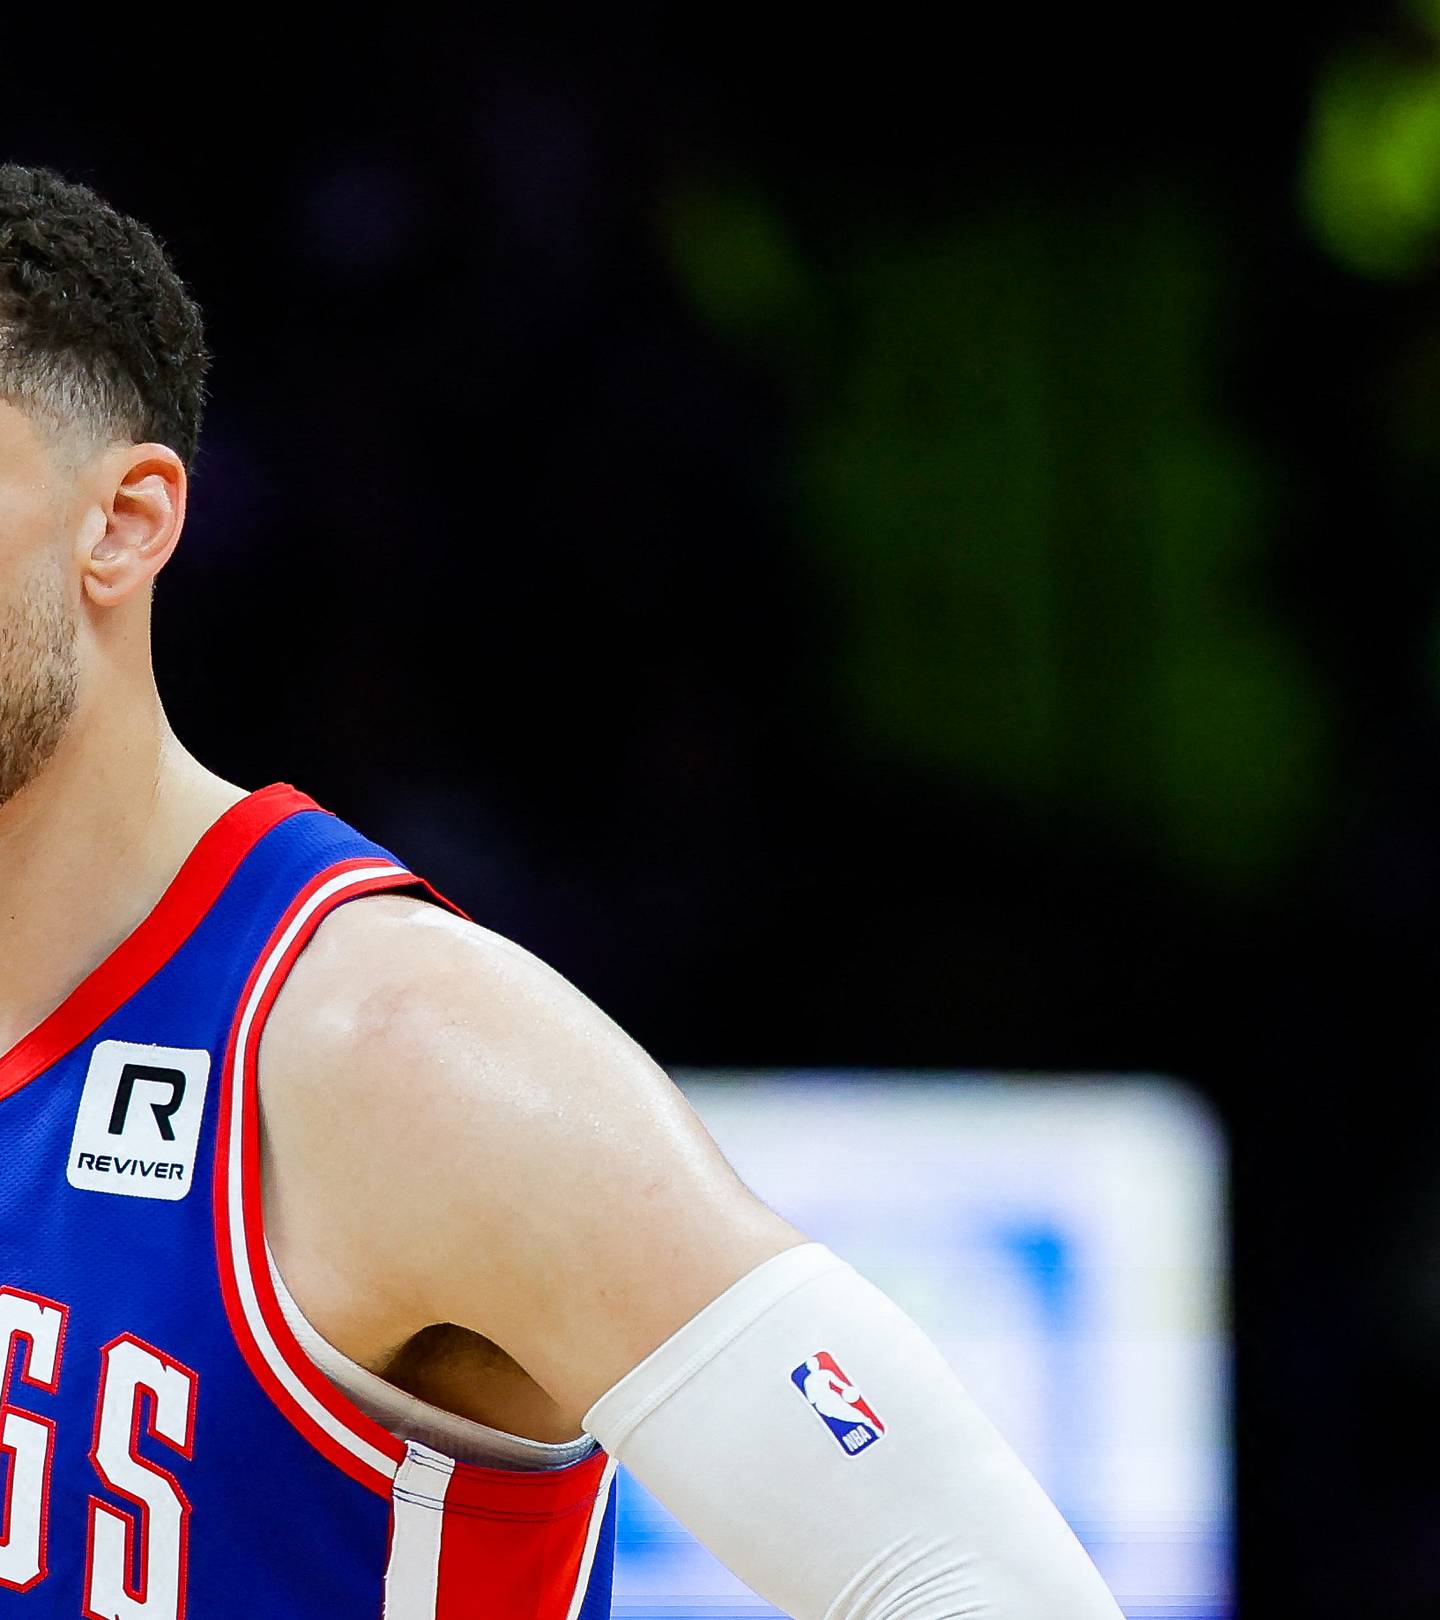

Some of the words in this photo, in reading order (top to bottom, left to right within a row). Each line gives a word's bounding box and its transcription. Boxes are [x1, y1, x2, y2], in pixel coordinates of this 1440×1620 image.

[108, 1063, 187, 1141] R
[77, 1152, 184, 1180] REVIVER
[842, 1424, 872, 1452] NBA
